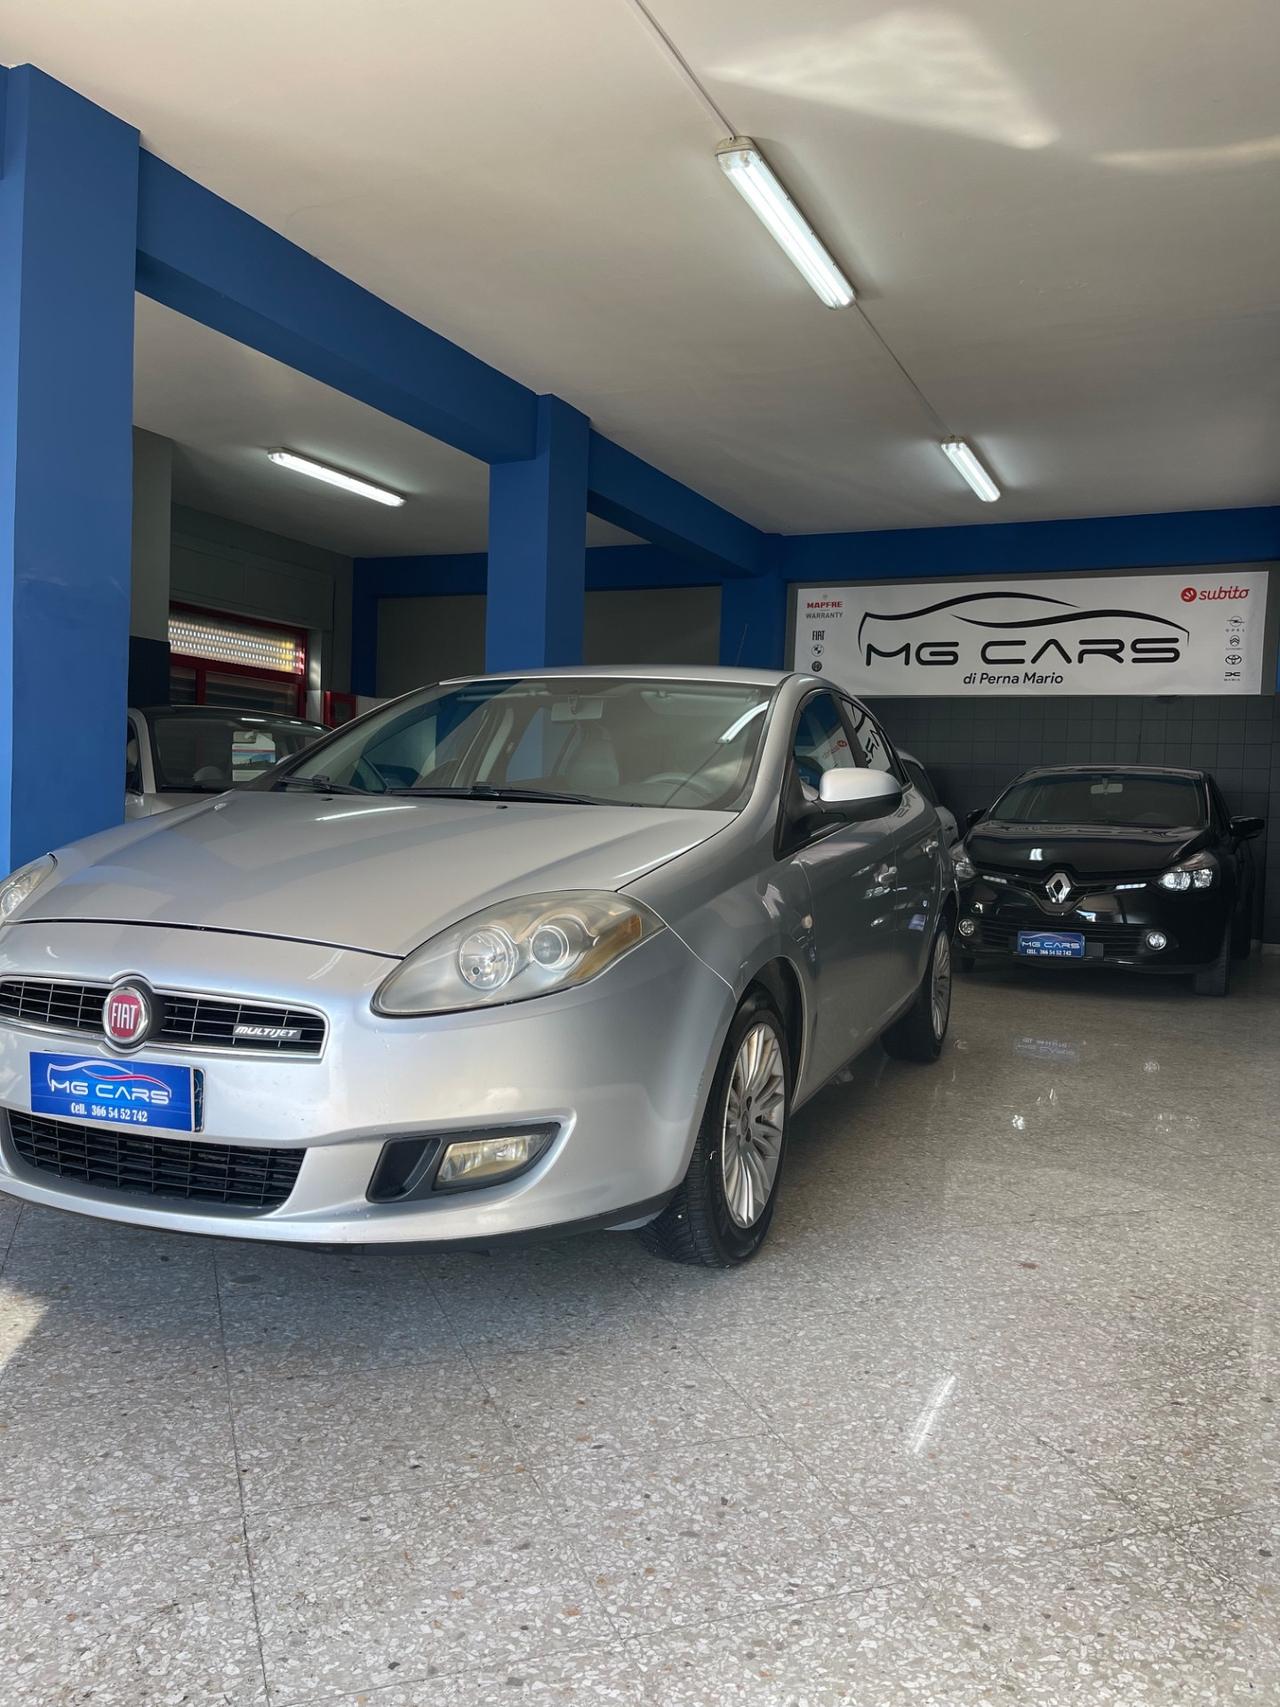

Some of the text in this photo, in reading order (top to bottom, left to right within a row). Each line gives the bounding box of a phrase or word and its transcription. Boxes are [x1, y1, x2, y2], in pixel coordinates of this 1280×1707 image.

[1199, 586, 1250, 600] subito
[806, 601, 843, 609] MAPFRE
[805, 611, 844, 619] WARRANTY
[812, 630, 825, 641] FIAT
[866, 637, 1180, 666] MG CARS
[963, 671, 1064, 685] di Perna Mario
[1043, 941, 1080, 949] CARS
[111, 1002, 138, 1030] FIAT
[235, 1025, 297, 1038] MULTIJET
[51, 1079, 170, 1105] MG CARS
[71, 1102, 148, 1122] Cell. 366 54 52 742
